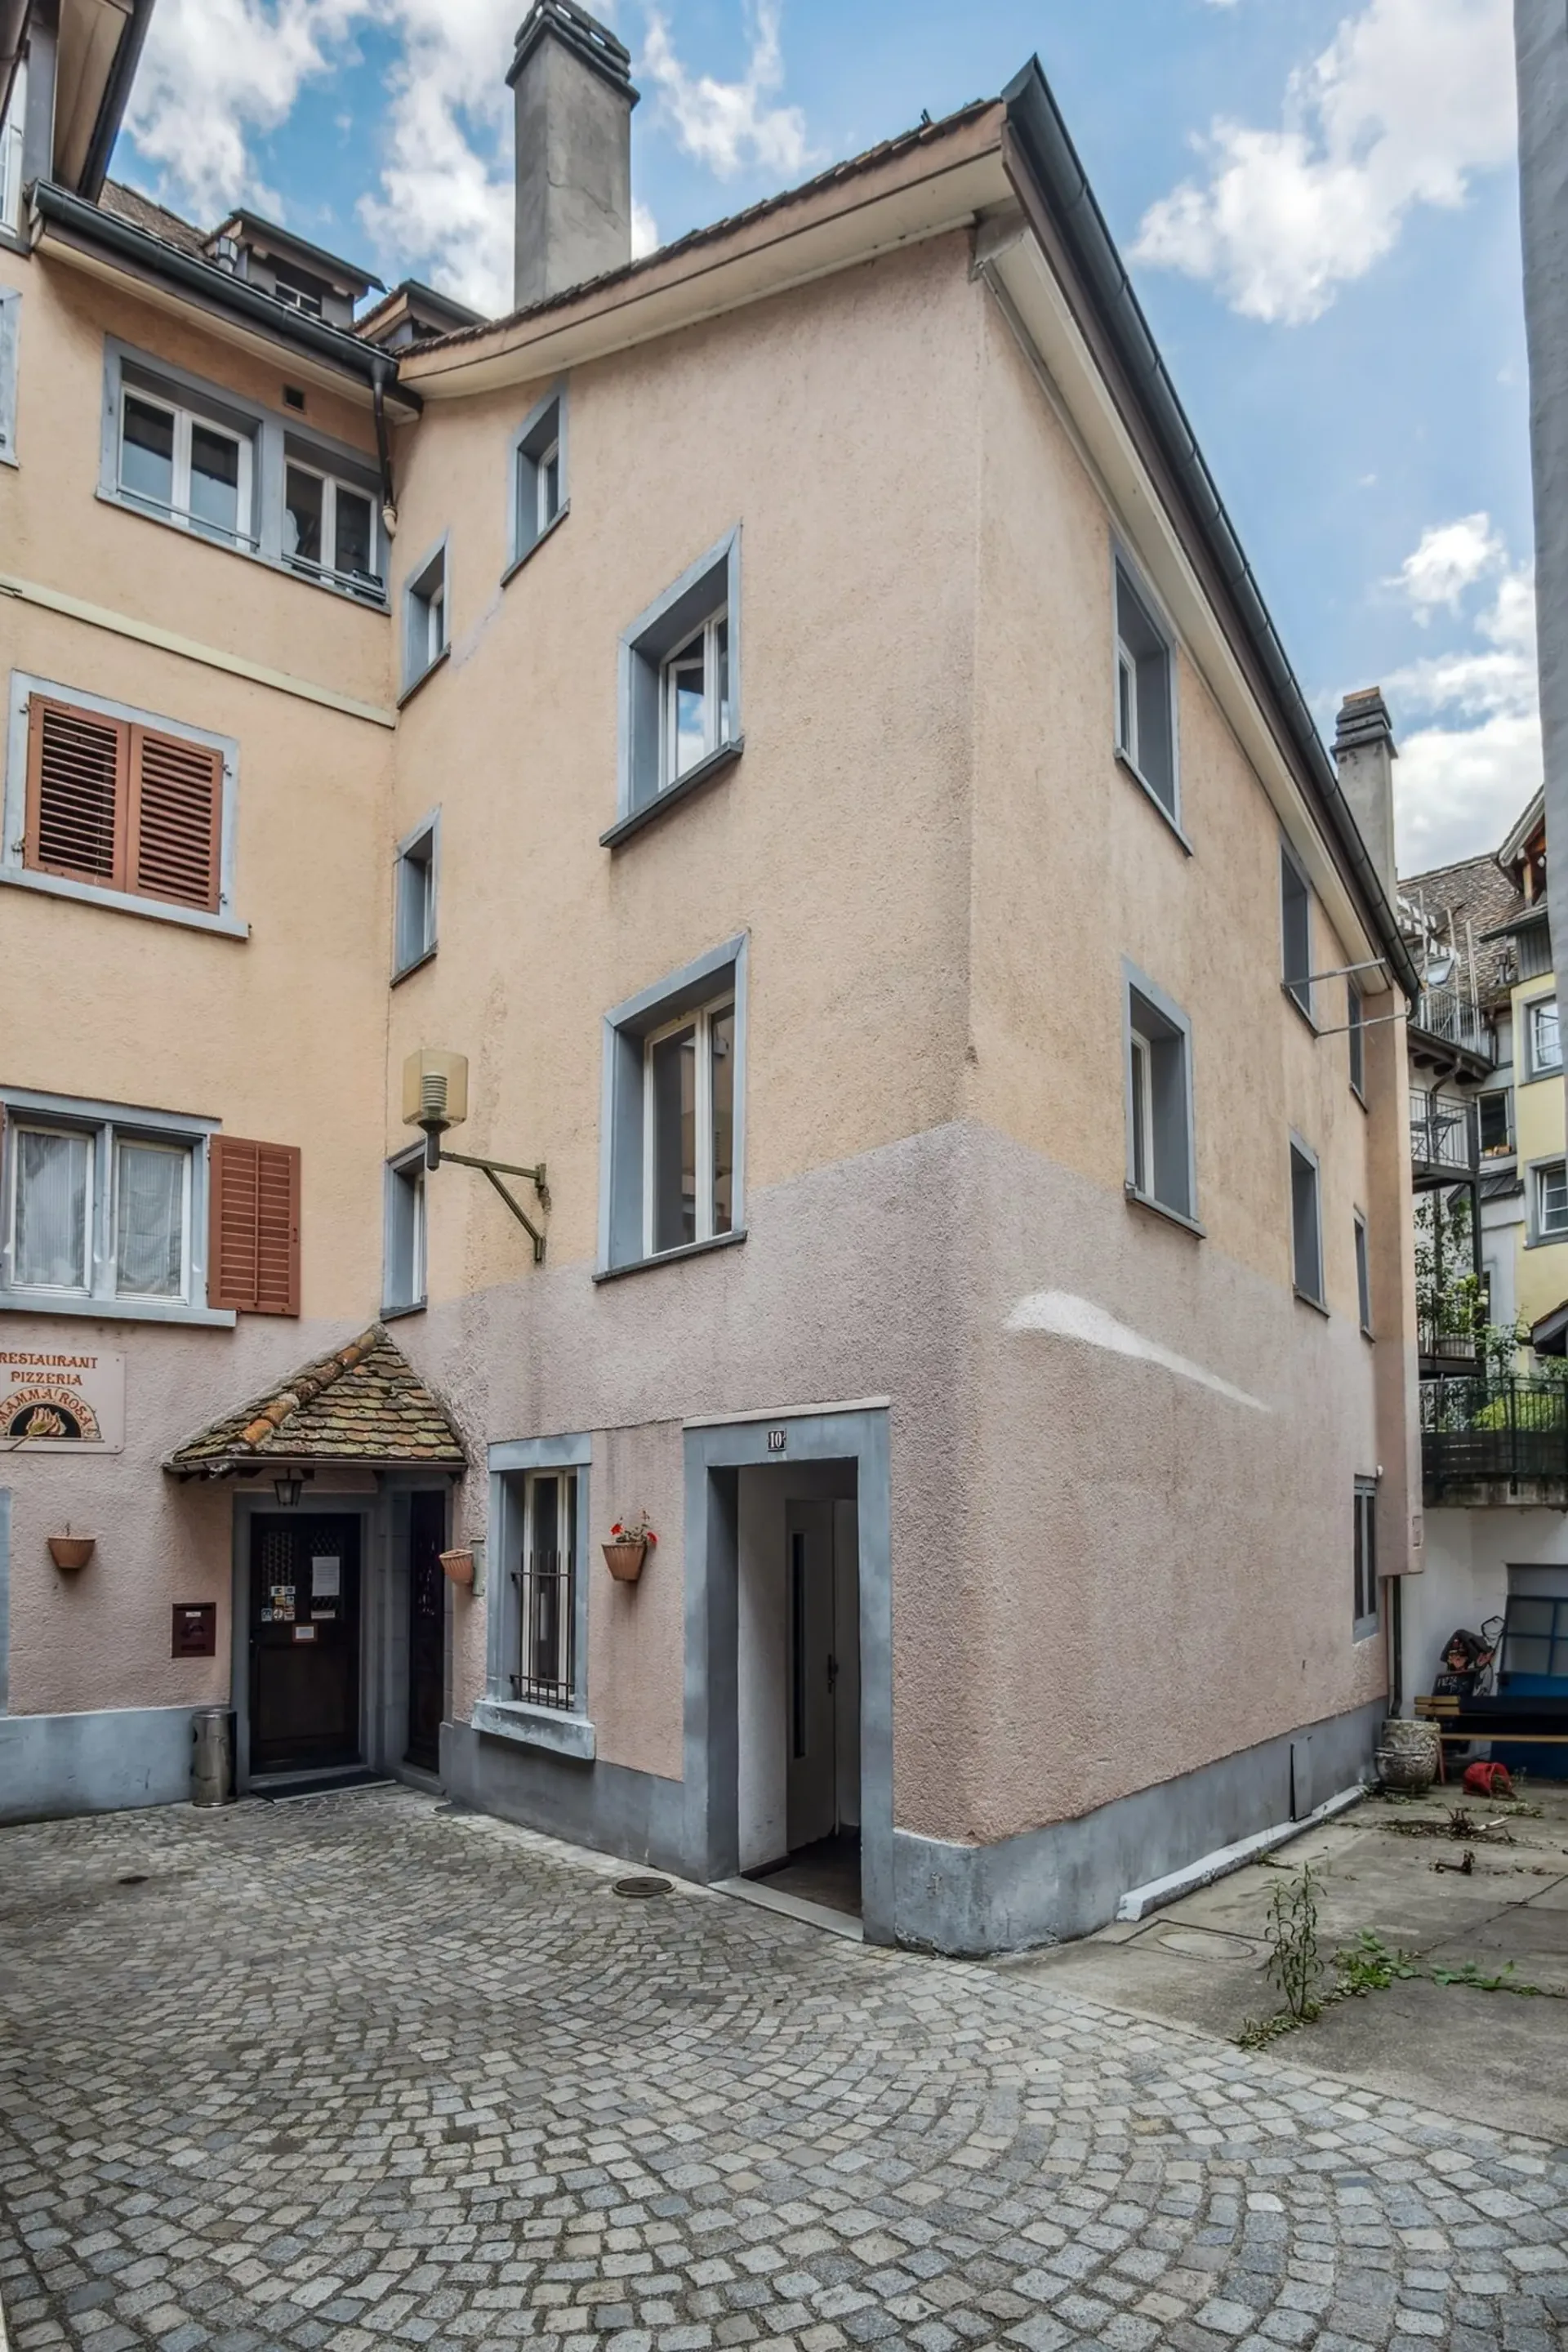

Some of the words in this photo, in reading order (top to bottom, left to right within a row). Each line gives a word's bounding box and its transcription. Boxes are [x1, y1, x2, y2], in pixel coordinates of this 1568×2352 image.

[0, 1352, 98, 1369] RESTAURANT
[11, 1371, 82, 1386] PIZZERIA
[59, 1392, 92, 1426] ROSA
[770, 1432, 782, 1448] 10
